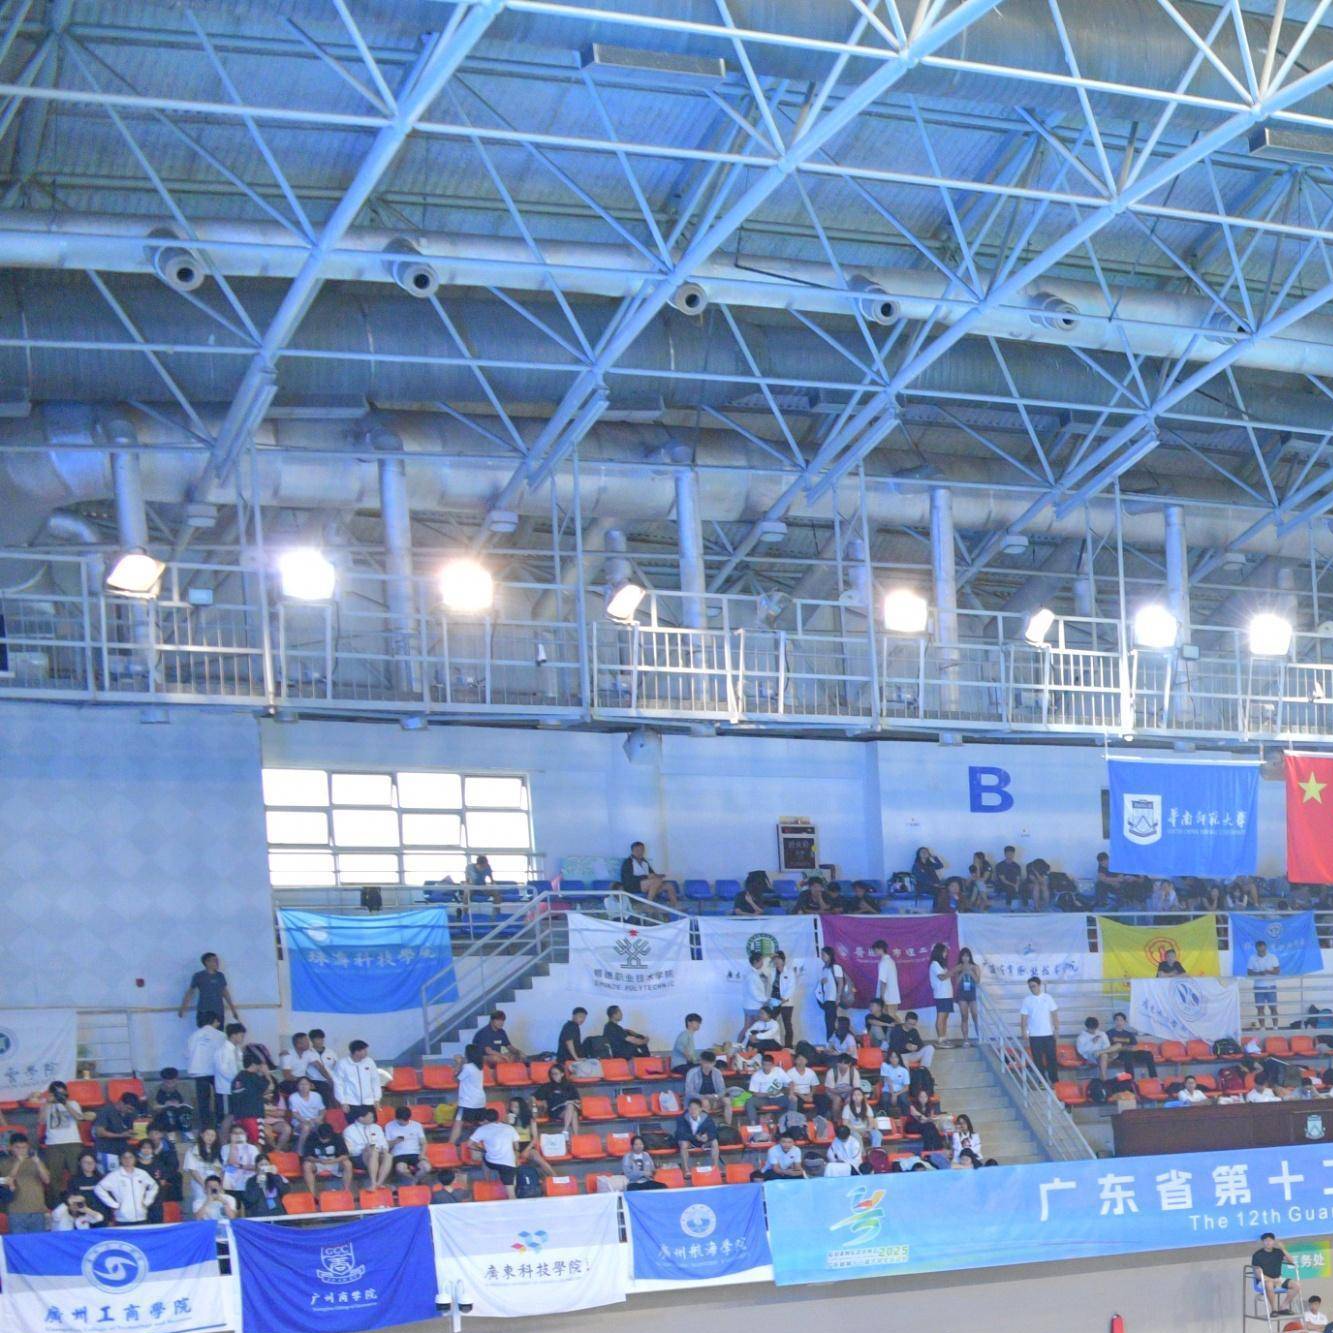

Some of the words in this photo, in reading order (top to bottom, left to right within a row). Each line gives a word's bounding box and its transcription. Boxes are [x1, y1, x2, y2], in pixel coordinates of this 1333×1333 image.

[968, 766, 1014, 813] B
[1190, 1214, 1216, 1232] The
[1236, 1207, 1282, 1228] 12th
